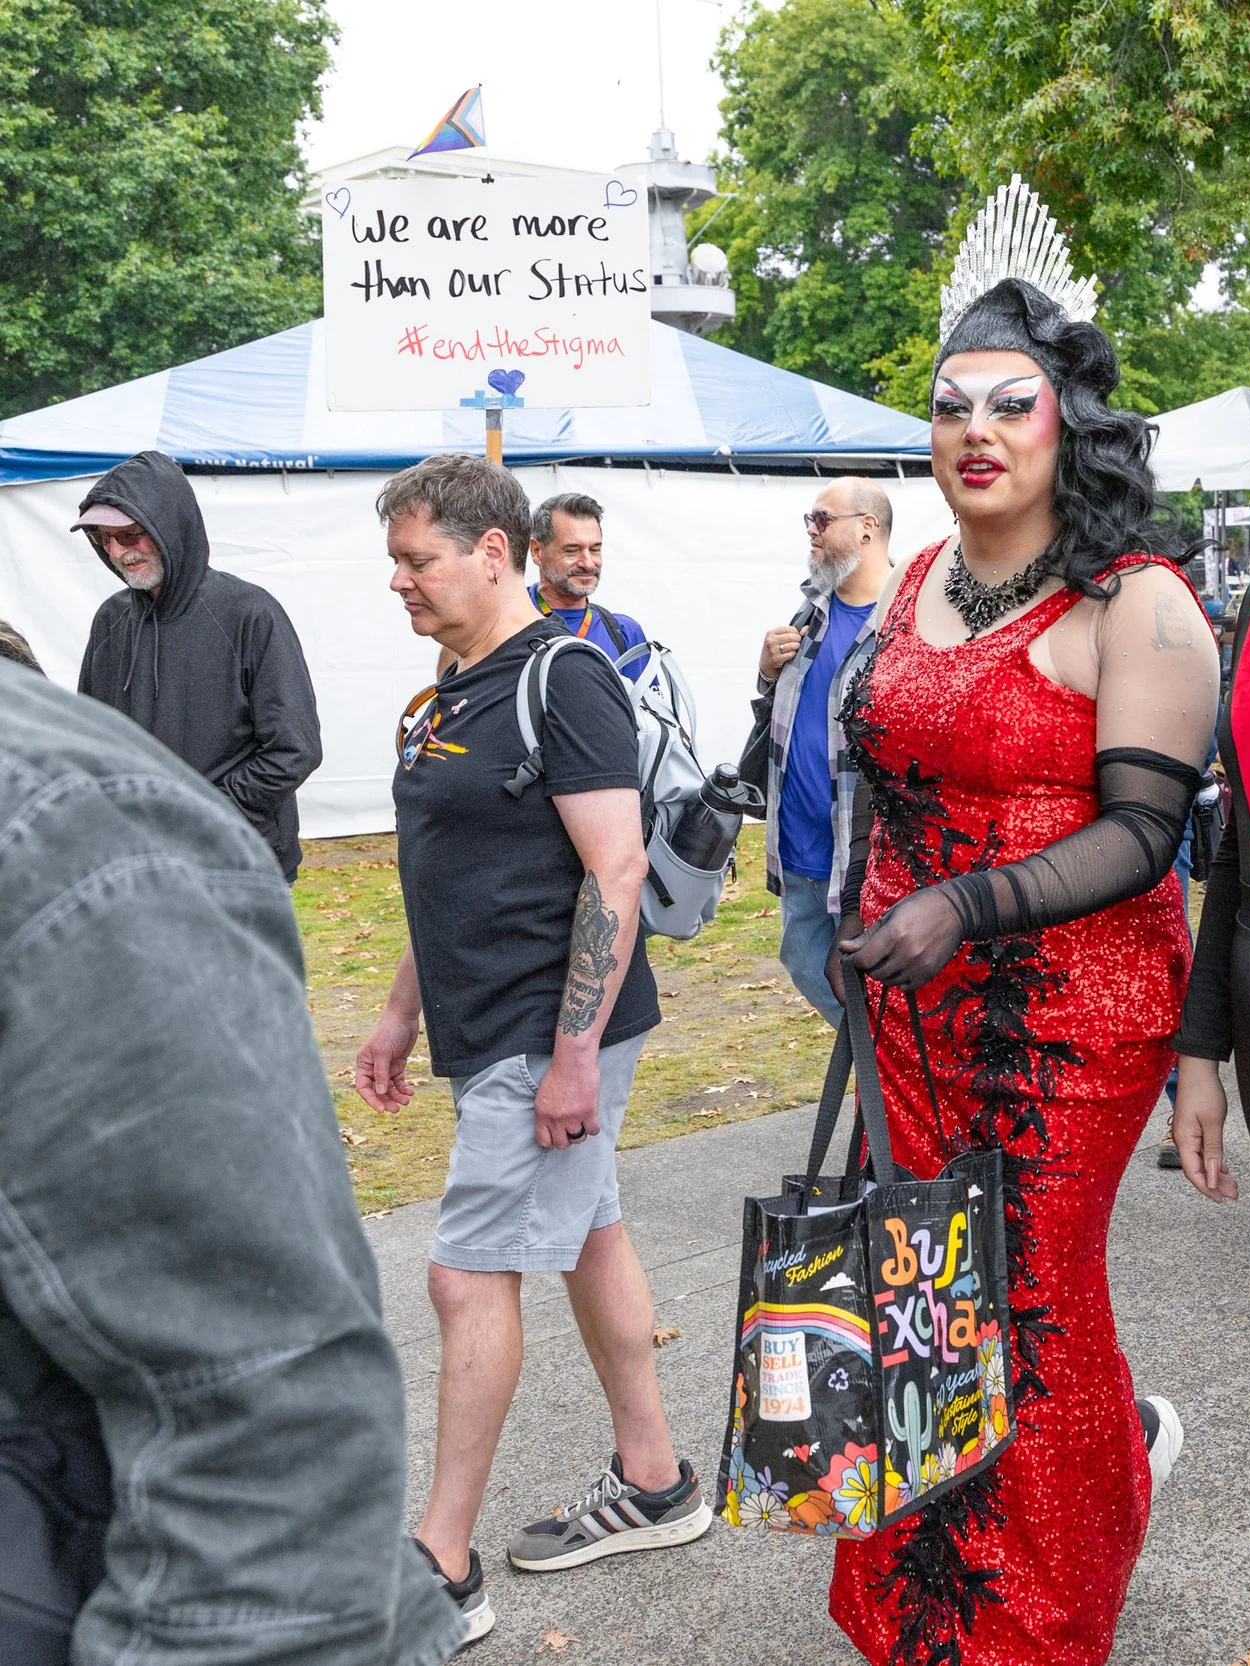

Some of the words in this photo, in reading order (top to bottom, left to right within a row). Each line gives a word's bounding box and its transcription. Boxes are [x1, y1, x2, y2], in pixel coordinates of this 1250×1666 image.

[352, 209, 409, 243] We
[427, 213, 489, 242] are
[512, 213, 610, 242] more
[350, 259, 431, 303] than
[448, 267, 511, 298] our
[785, 1245, 844, 1288] Fashion
[763, 1338, 800, 1355] BUY
[762, 1354, 801, 1370] SELL
[762, 1369, 803, 1384] TRADE
[761, 1382, 804, 1396] SINCE
[762, 1397, 805, 1416] 1974
